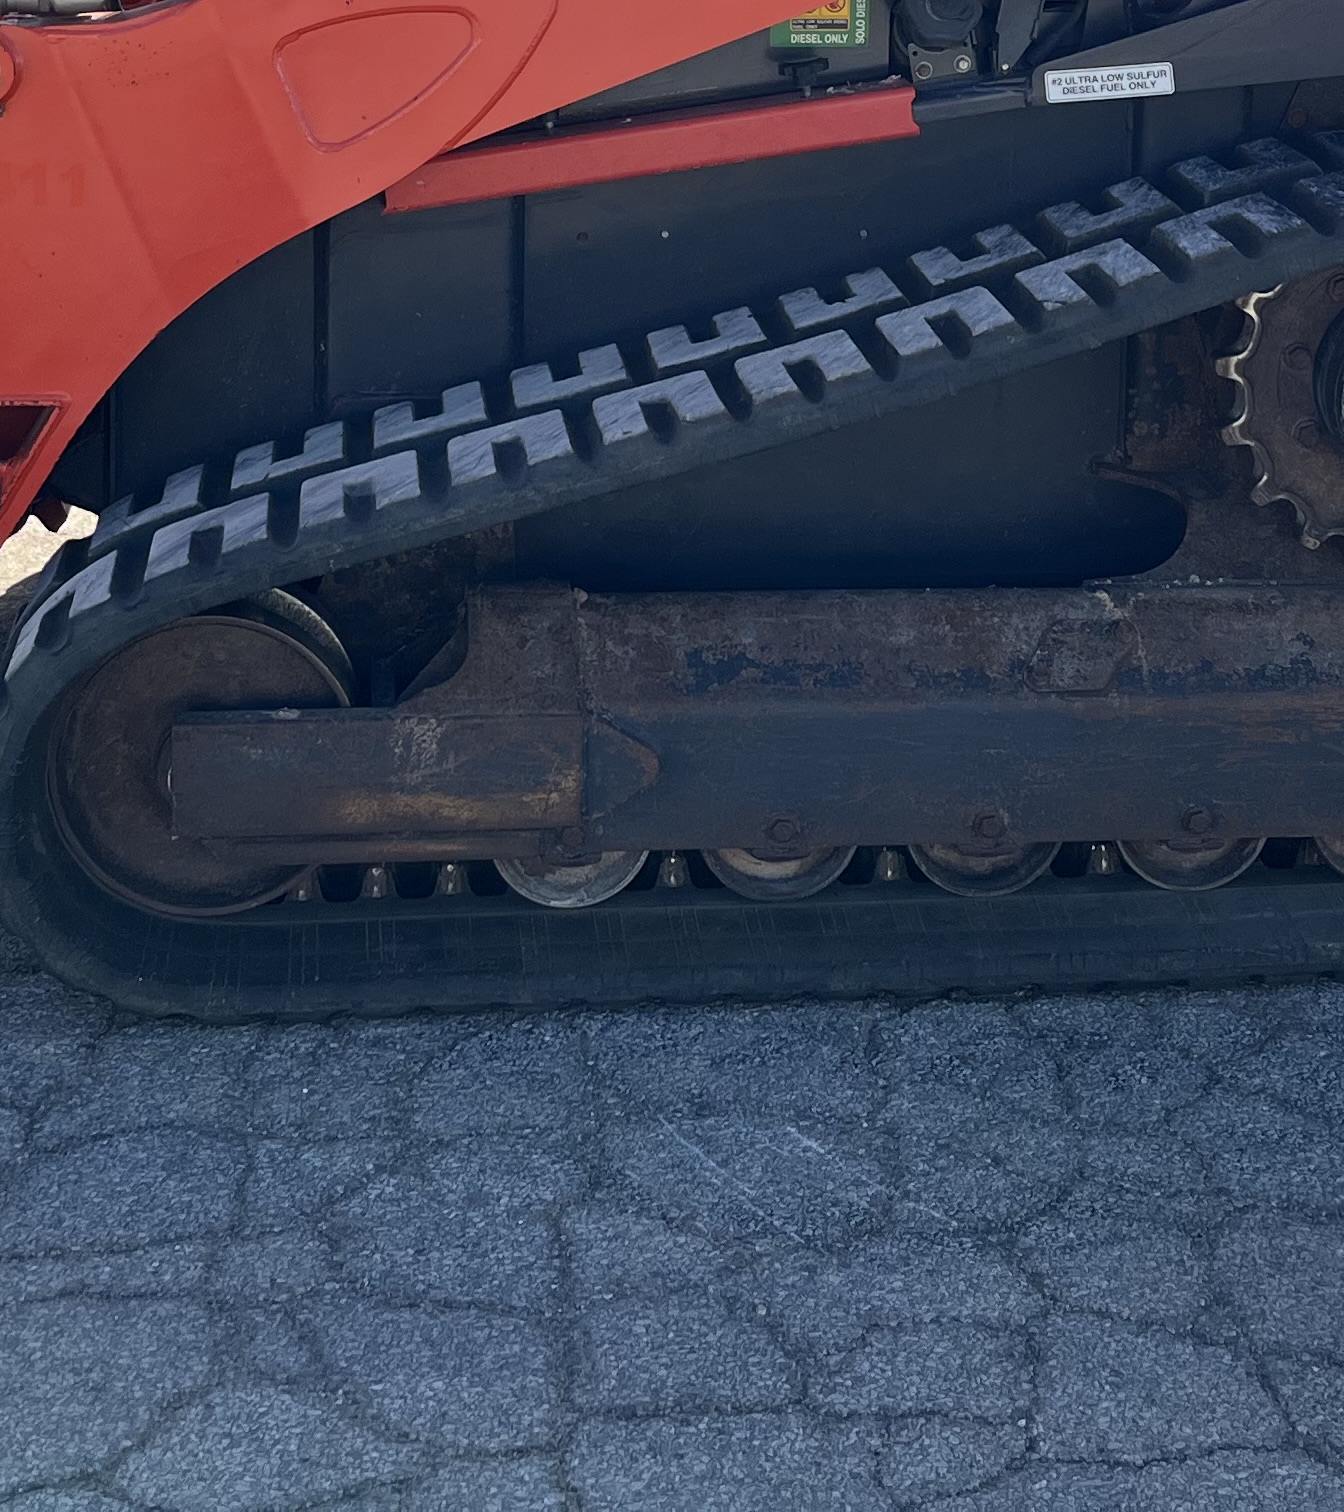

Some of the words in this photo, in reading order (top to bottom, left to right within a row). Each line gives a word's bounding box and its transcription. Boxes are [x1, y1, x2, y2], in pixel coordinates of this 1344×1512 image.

[790, 33, 822, 44] DIESEL
[824, 33, 849, 44] ONLY
[855, 19, 866, 44] SOLO
[1051, 77, 1063, 86] #2
[1064, 75, 1099, 86] ULTRA
[1101, 73, 1124, 83] LOW
[1126, 69, 1168, 80] SULFUR
[1062, 85, 1098, 95] DIESEL
[1100, 83, 1126, 93] FUEL
[1128, 80, 1157, 90] ONLY
